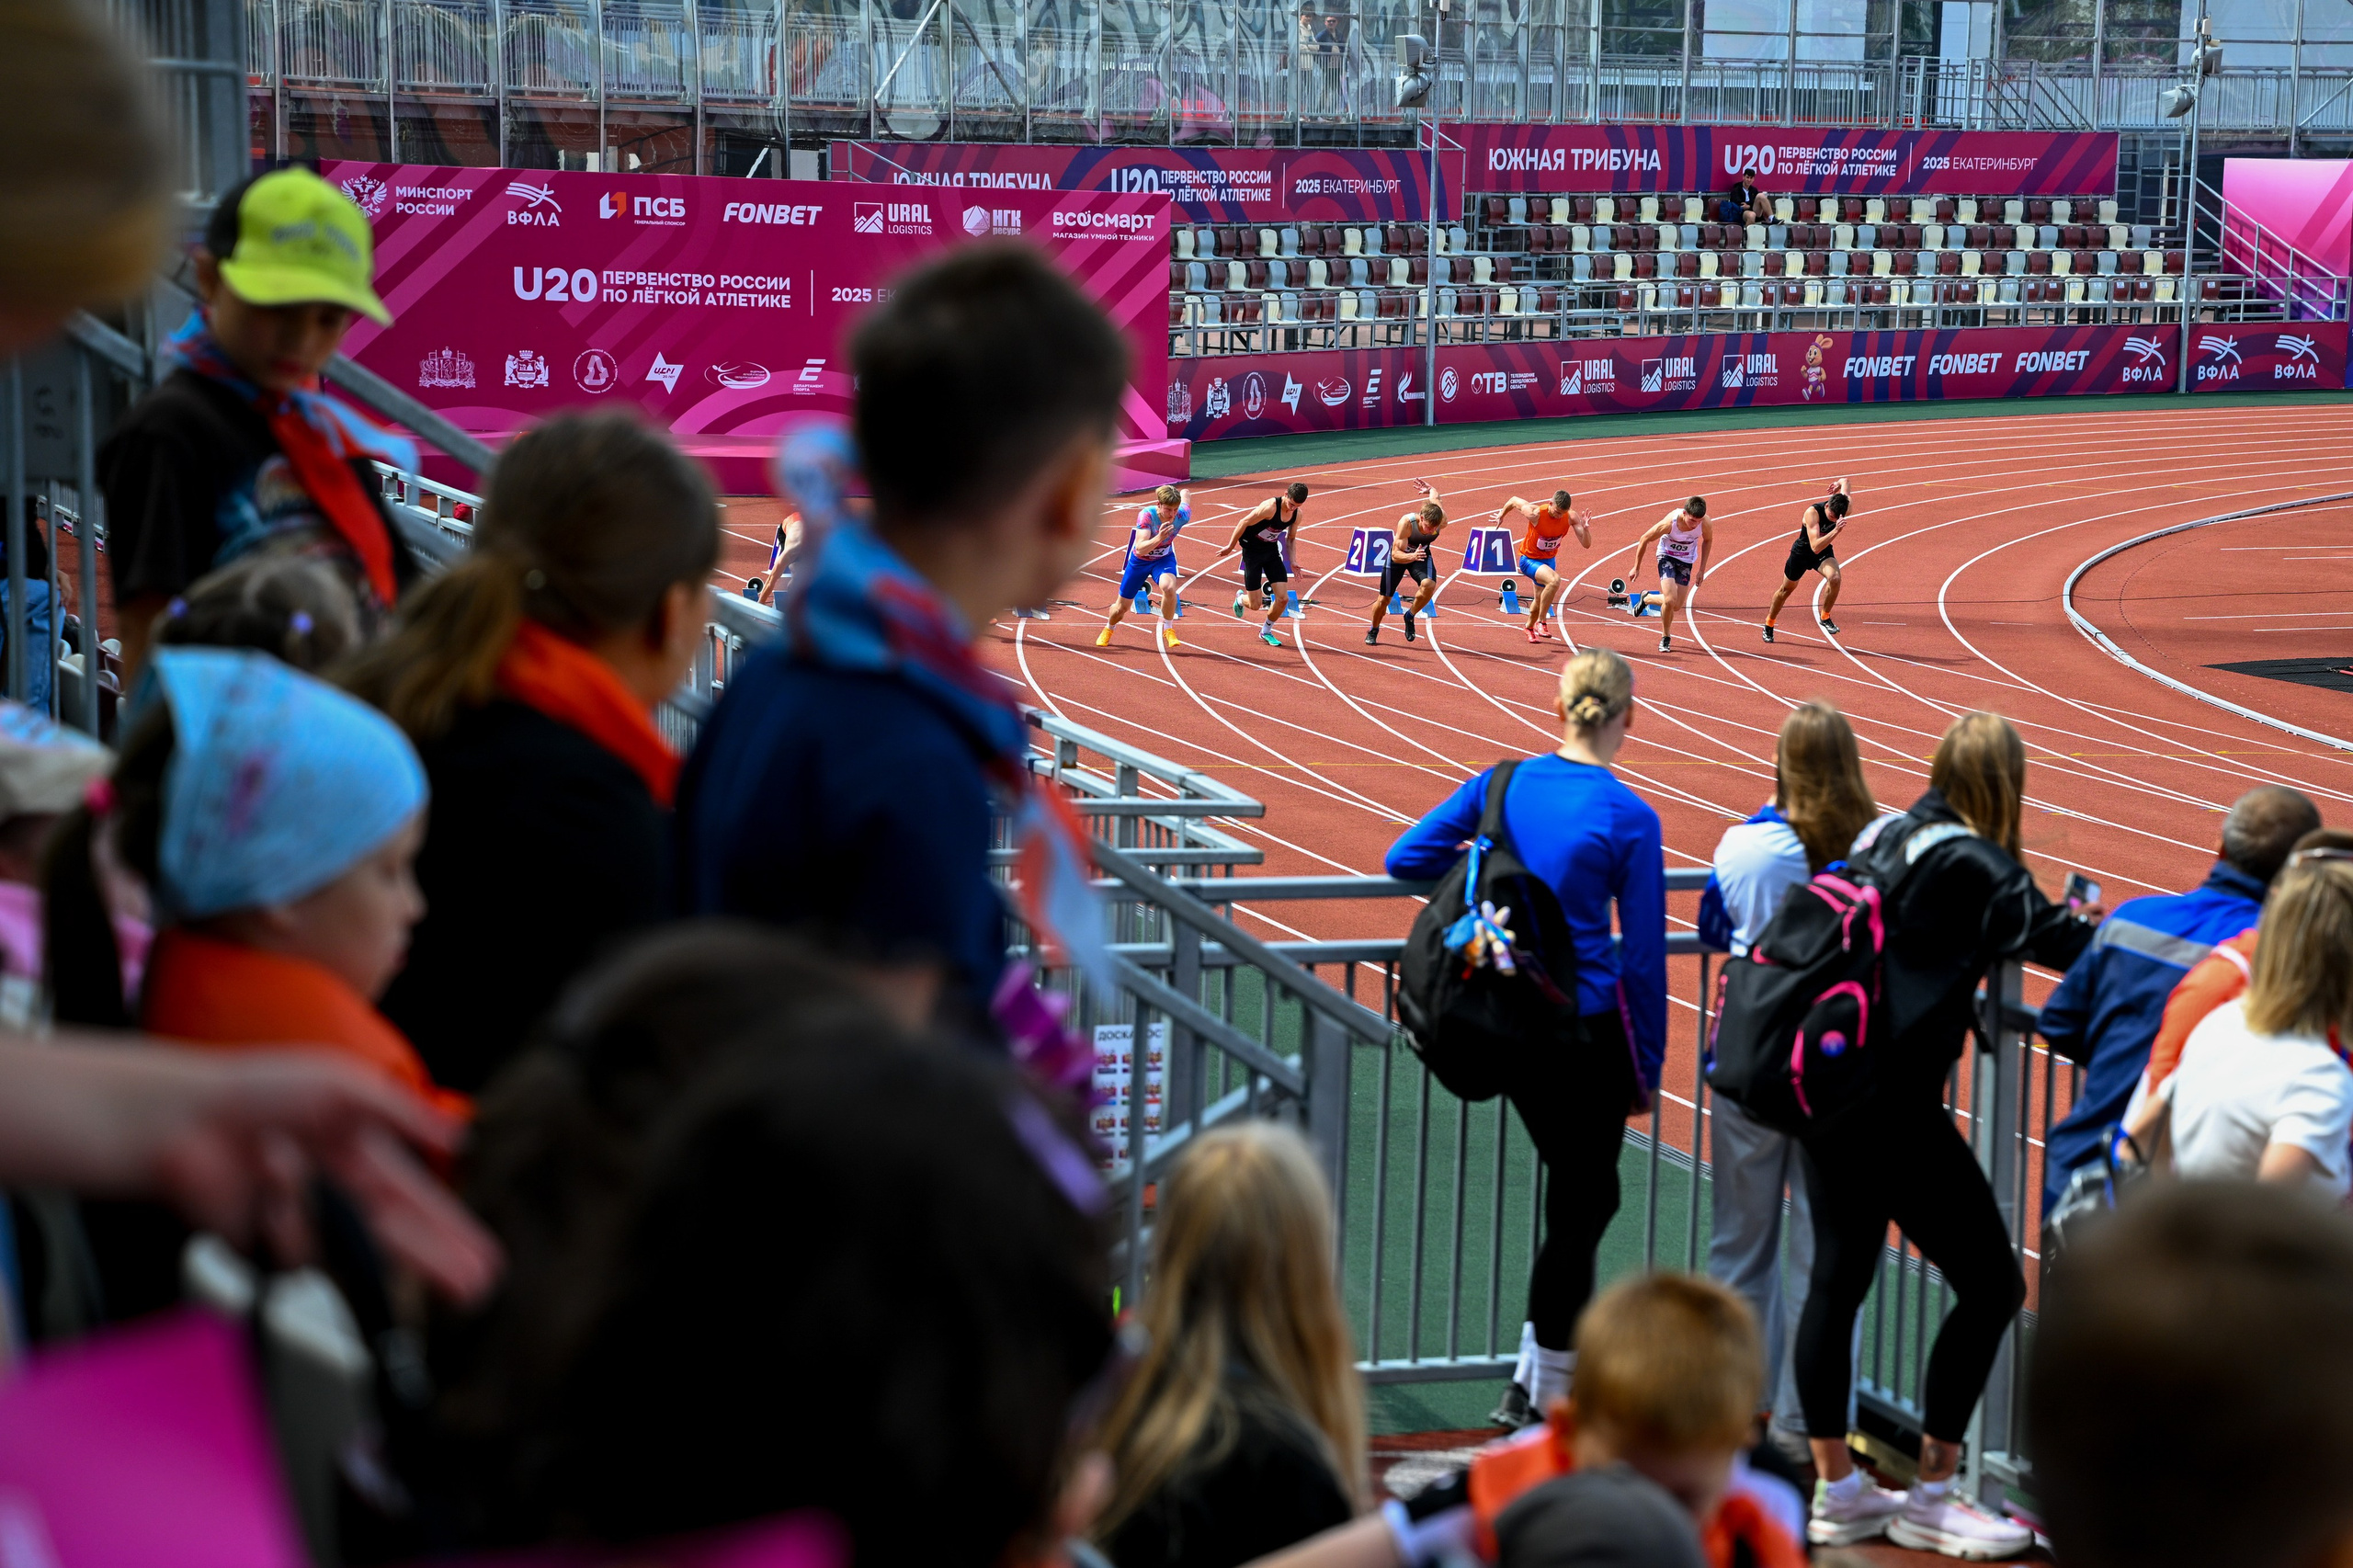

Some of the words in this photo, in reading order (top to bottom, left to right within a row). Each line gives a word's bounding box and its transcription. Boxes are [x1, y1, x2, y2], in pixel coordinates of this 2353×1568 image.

[1489, 148, 1565, 171] ЮЖНАЯ
[1571, 148, 1662, 171] ТРИБУНА
[1724, 144, 1776, 176] U20
[1779, 145, 1849, 161] ПЕРВЕНСТВО
[1852, 148, 1897, 162] РОССИИ
[1778, 162, 1792, 175] ПО
[1795, 159, 1838, 176] ЛЁГКОЙ
[1841, 163, 1896, 177] АТЛЕТИКЕ
[1923, 156, 1949, 170] 2025
[1952, 156, 2038, 171] ЕКАТЕРИНБУРГ
[1111, 168, 1159, 193] U20
[1161, 170, 1226, 184] ПЕРВЕНСТВО
[1230, 170, 1271, 185] РОССИИ
[1295, 178, 1321, 194] 2025
[1323, 178, 1402, 194] ЕКАТЕРИНБУРГ
[395, 187, 473, 200] МИНСПОРТ
[1177, 185, 1218, 202] ЛЁГКОЙ
[1220, 187, 1271, 202] АТЛЕТИКЕ
[395, 202, 455, 216] РОССИИ
[634, 196, 686, 218] ПСБ
[723, 202, 823, 226] FONBET
[888, 203, 932, 223] URAL
[507, 210, 561, 227] ВФЛА
[993, 210, 1021, 227] НГК
[888, 224, 932, 235] LOGISTICS
[993, 226, 1021, 236] ресурс
[1091, 233, 1118, 241] УМНОЙ
[514, 266, 598, 302] U20
[603, 270, 715, 288] ПЕРВЕНСТВО
[721, 275, 790, 290] РОССИИ
[603, 289, 628, 303] ПО
[632, 287, 700, 305] ЛЁГКОЙ
[705, 291, 791, 309] АТЛЕТИКЕ
[832, 287, 872, 302] 2025
[1585, 358, 1616, 380] URAL
[1665, 357, 1697, 379] URAL
[1746, 353, 1779, 375] URAL
[1843, 355, 1915, 378] FONBET
[1928, 352, 2003, 376] FONBET
[2015, 350, 2090, 373] FONBET
[2122, 366, 2163, 382] ВФЛА
[2198, 364, 2239, 381] ВФЛА
[2275, 363, 2316, 379] ВФЛА
[1471, 371, 1507, 394] ОТВ
[1584, 381, 1615, 393] LOGISTICS
[1664, 379, 1697, 392] LOGISTICS
[1746, 375, 1779, 388] LOGISTICS
[1349, 537, 1362, 566] 2
[1373, 538, 1390, 566] 2
[1470, 537, 1479, 565] 1
[1491, 539, 1504, 566] 1
[1670, 543, 1688, 551] 403
